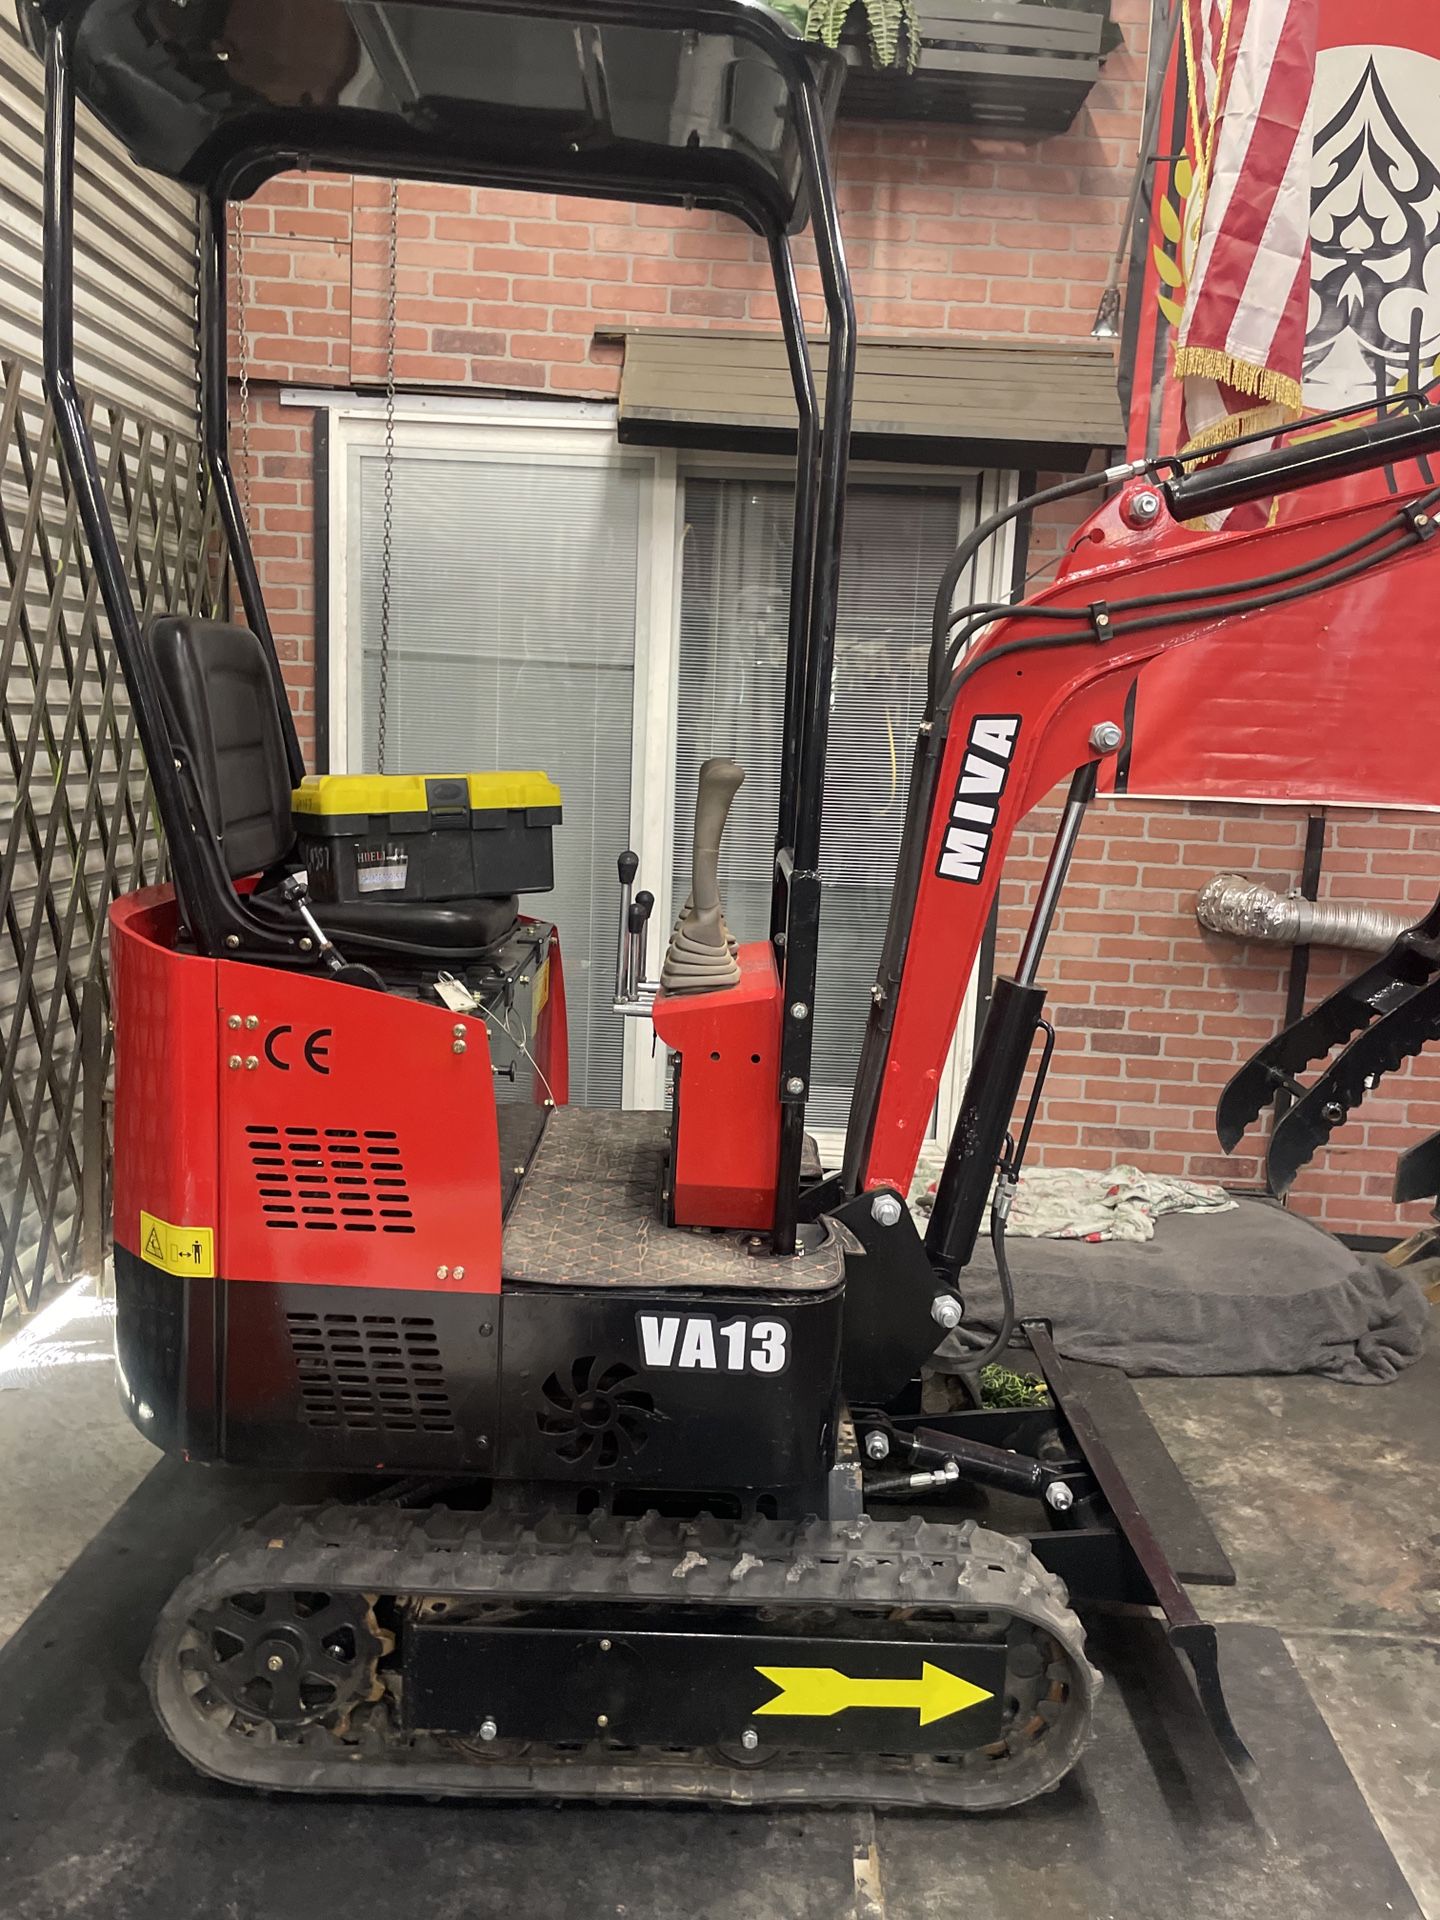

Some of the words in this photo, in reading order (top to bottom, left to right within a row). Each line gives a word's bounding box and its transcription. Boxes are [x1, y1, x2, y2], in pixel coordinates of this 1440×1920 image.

[938, 718, 1019, 881] MIVA
[264, 1025, 332, 1075] CE
[640, 1315, 787, 1373] VA13
